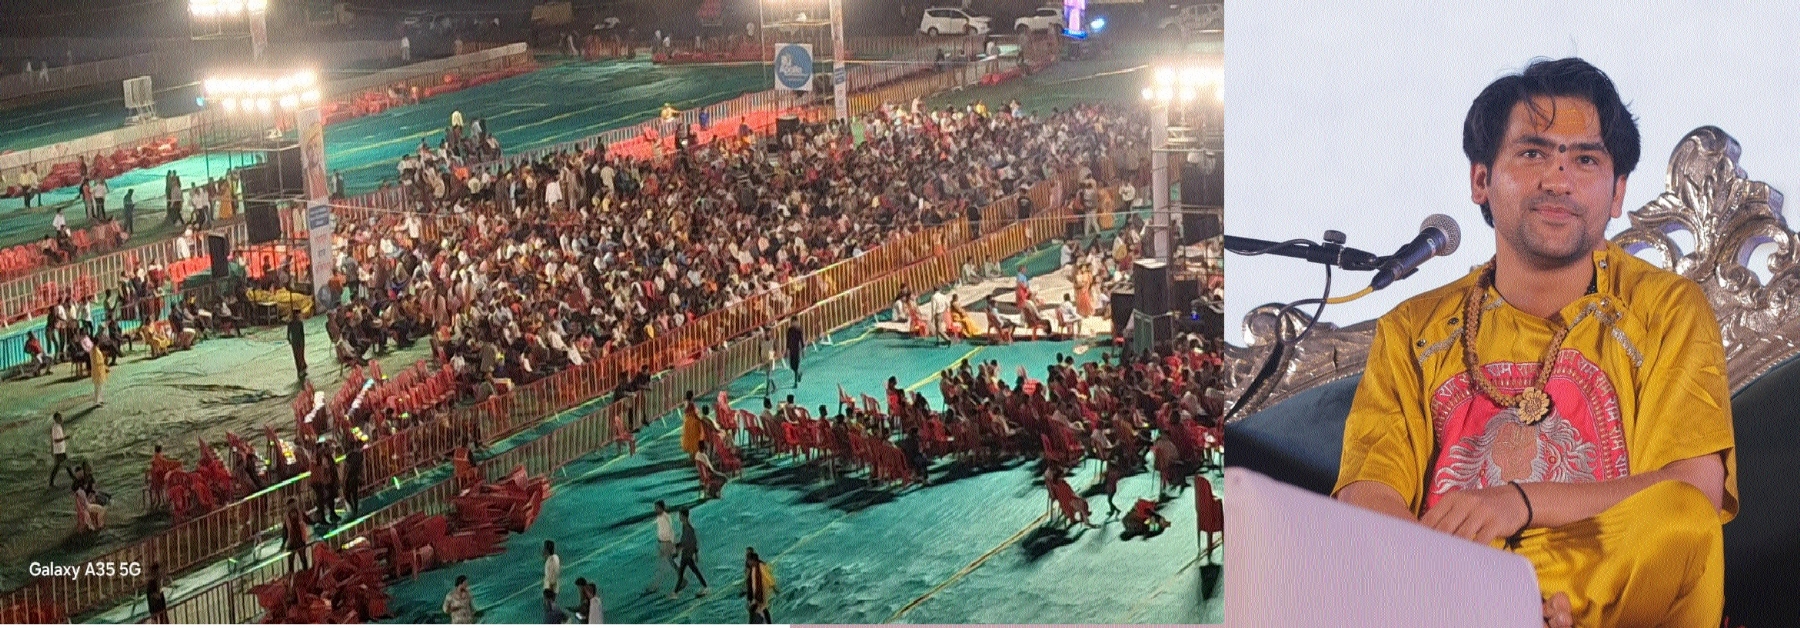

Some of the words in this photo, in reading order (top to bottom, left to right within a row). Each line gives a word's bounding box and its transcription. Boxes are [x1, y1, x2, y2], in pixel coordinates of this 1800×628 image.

[1485, 362, 1512, 377] राम
[1578, 355, 1599, 379] राम
[1604, 396, 1620, 422] राम
[1609, 423, 1625, 450] राम
